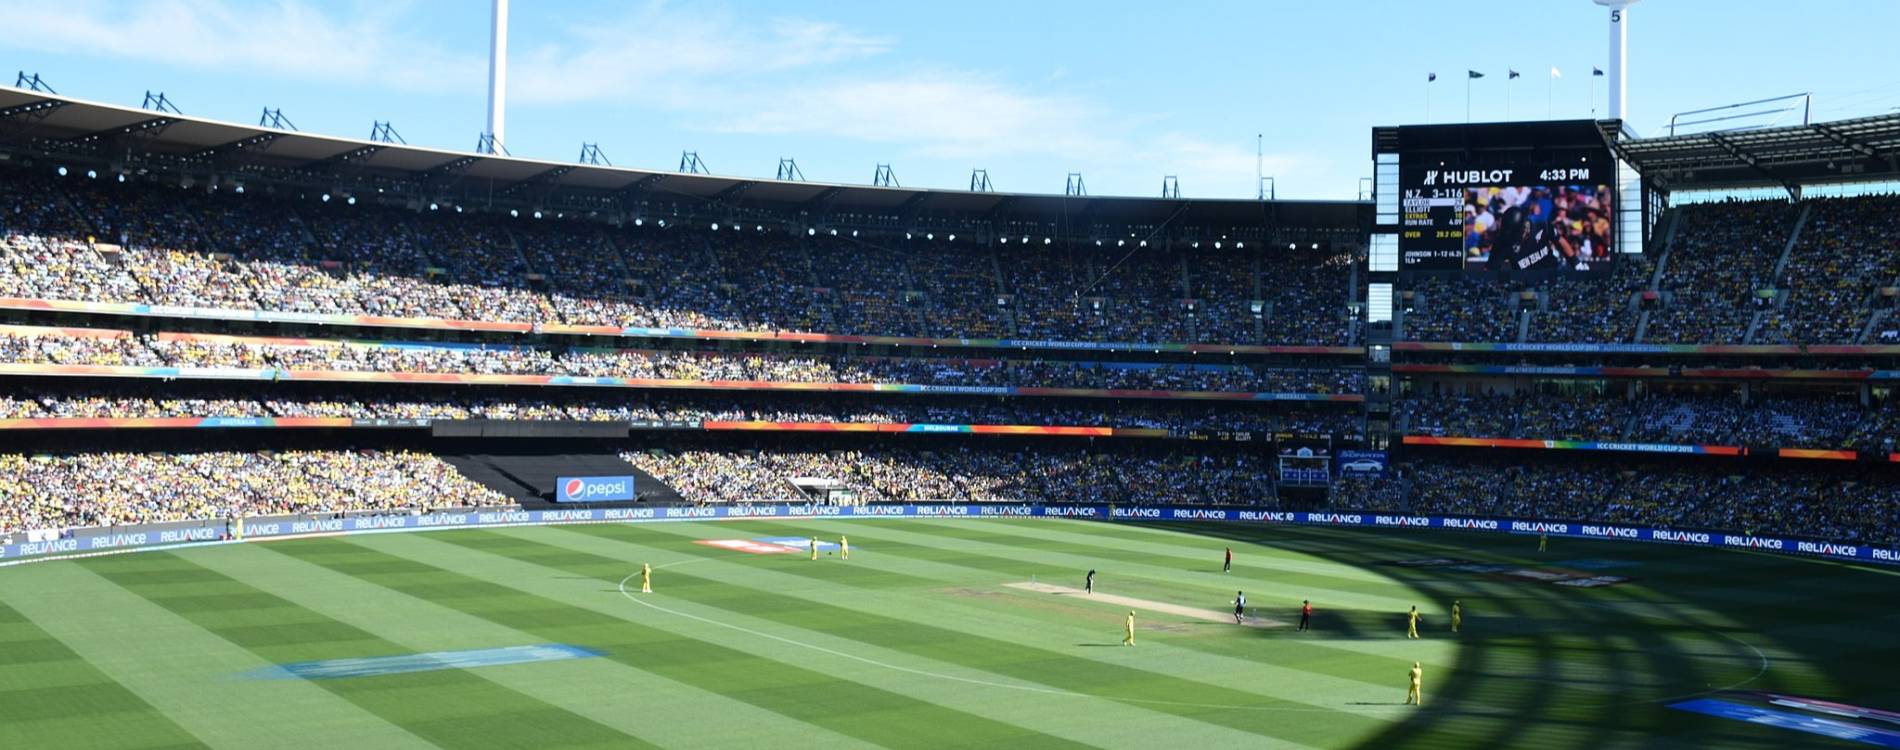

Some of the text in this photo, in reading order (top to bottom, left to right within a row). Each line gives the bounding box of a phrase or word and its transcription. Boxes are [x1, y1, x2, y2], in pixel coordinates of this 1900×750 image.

[1611, 10, 1620, 23] 5
[1443, 170, 1513, 184] HUBLOT
[1540, 168, 1590, 181] 4:33 PM
[1432, 188, 1462, 198] 3-116
[587, 480, 626, 497] pepsi
